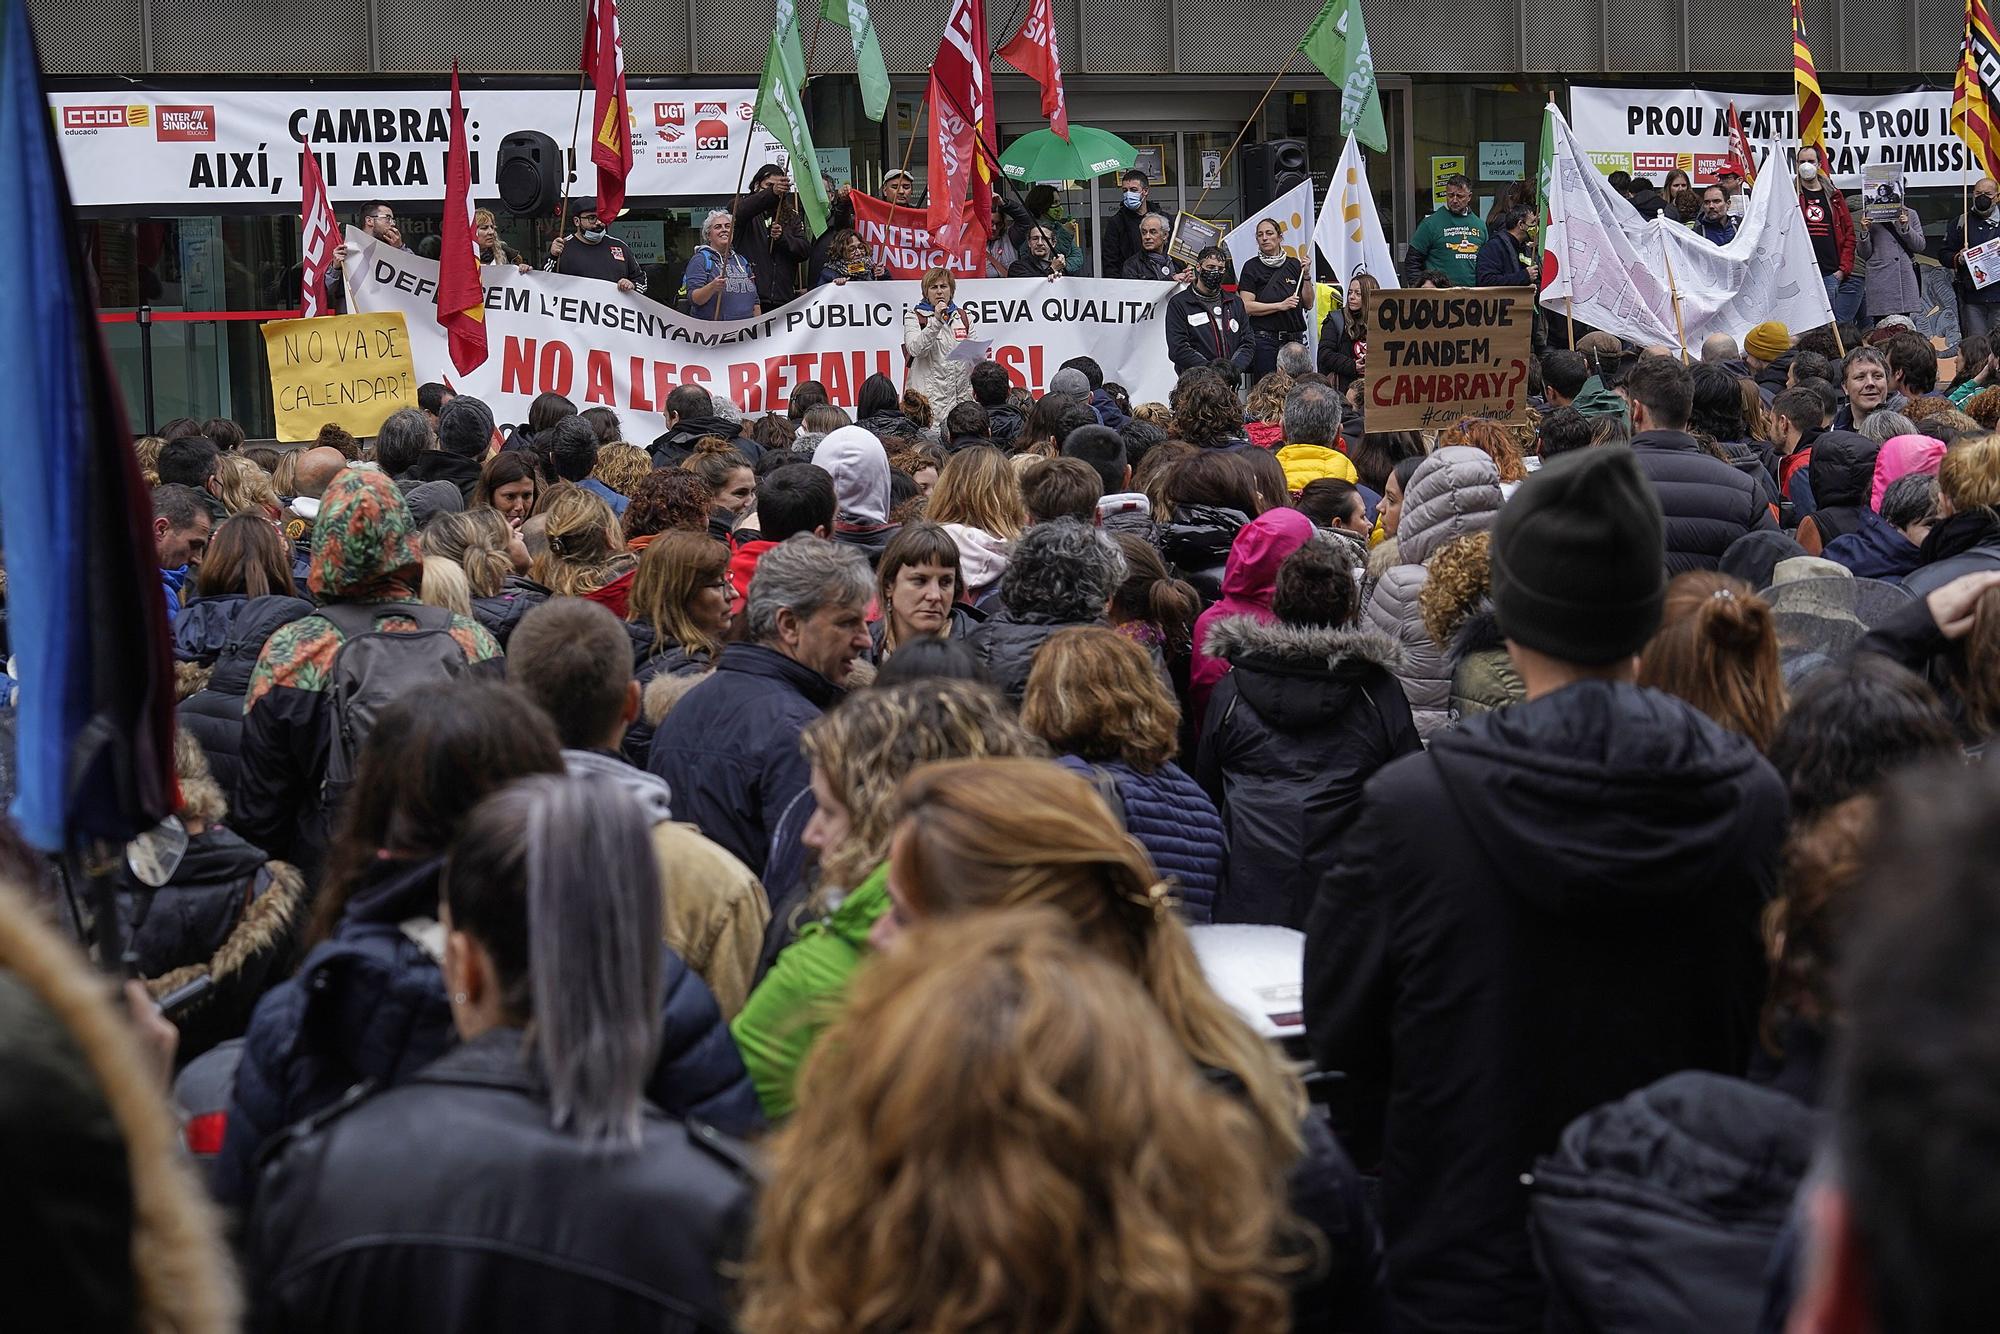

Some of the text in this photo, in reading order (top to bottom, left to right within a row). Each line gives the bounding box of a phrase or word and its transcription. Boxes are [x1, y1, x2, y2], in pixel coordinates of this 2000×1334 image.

[68, 110, 122, 124] CCOO
[163, 112, 190, 121] INTER
[163, 121, 208, 131] SINDICAL
[659, 104, 685, 119] UGT
[1628, 106, 1703, 136] PROU
[1859, 108, 1928, 139] PROU
[65, 128, 98, 136] educació
[696, 136, 727, 150] CGT
[189, 143, 282, 194] AIXÍ,
[353, 151, 428, 186] ARA
[1636, 156, 1674, 167] CCOO
[858, 219, 931, 248] INTER
[871, 244, 977, 271] INDICAL
[541, 293, 777, 346] L'ENSENYAMENT
[786, 301, 893, 332] PÚBLIC
[1378, 298, 1515, 333] QUOUSQUE
[284, 327, 402, 365] NO VA DE
[1384, 338, 1502, 367] TANDEM,
[501, 335, 574, 398] NO
[585, 349, 616, 408] A
[1372, 359, 1527, 410] CAMBRAY?
